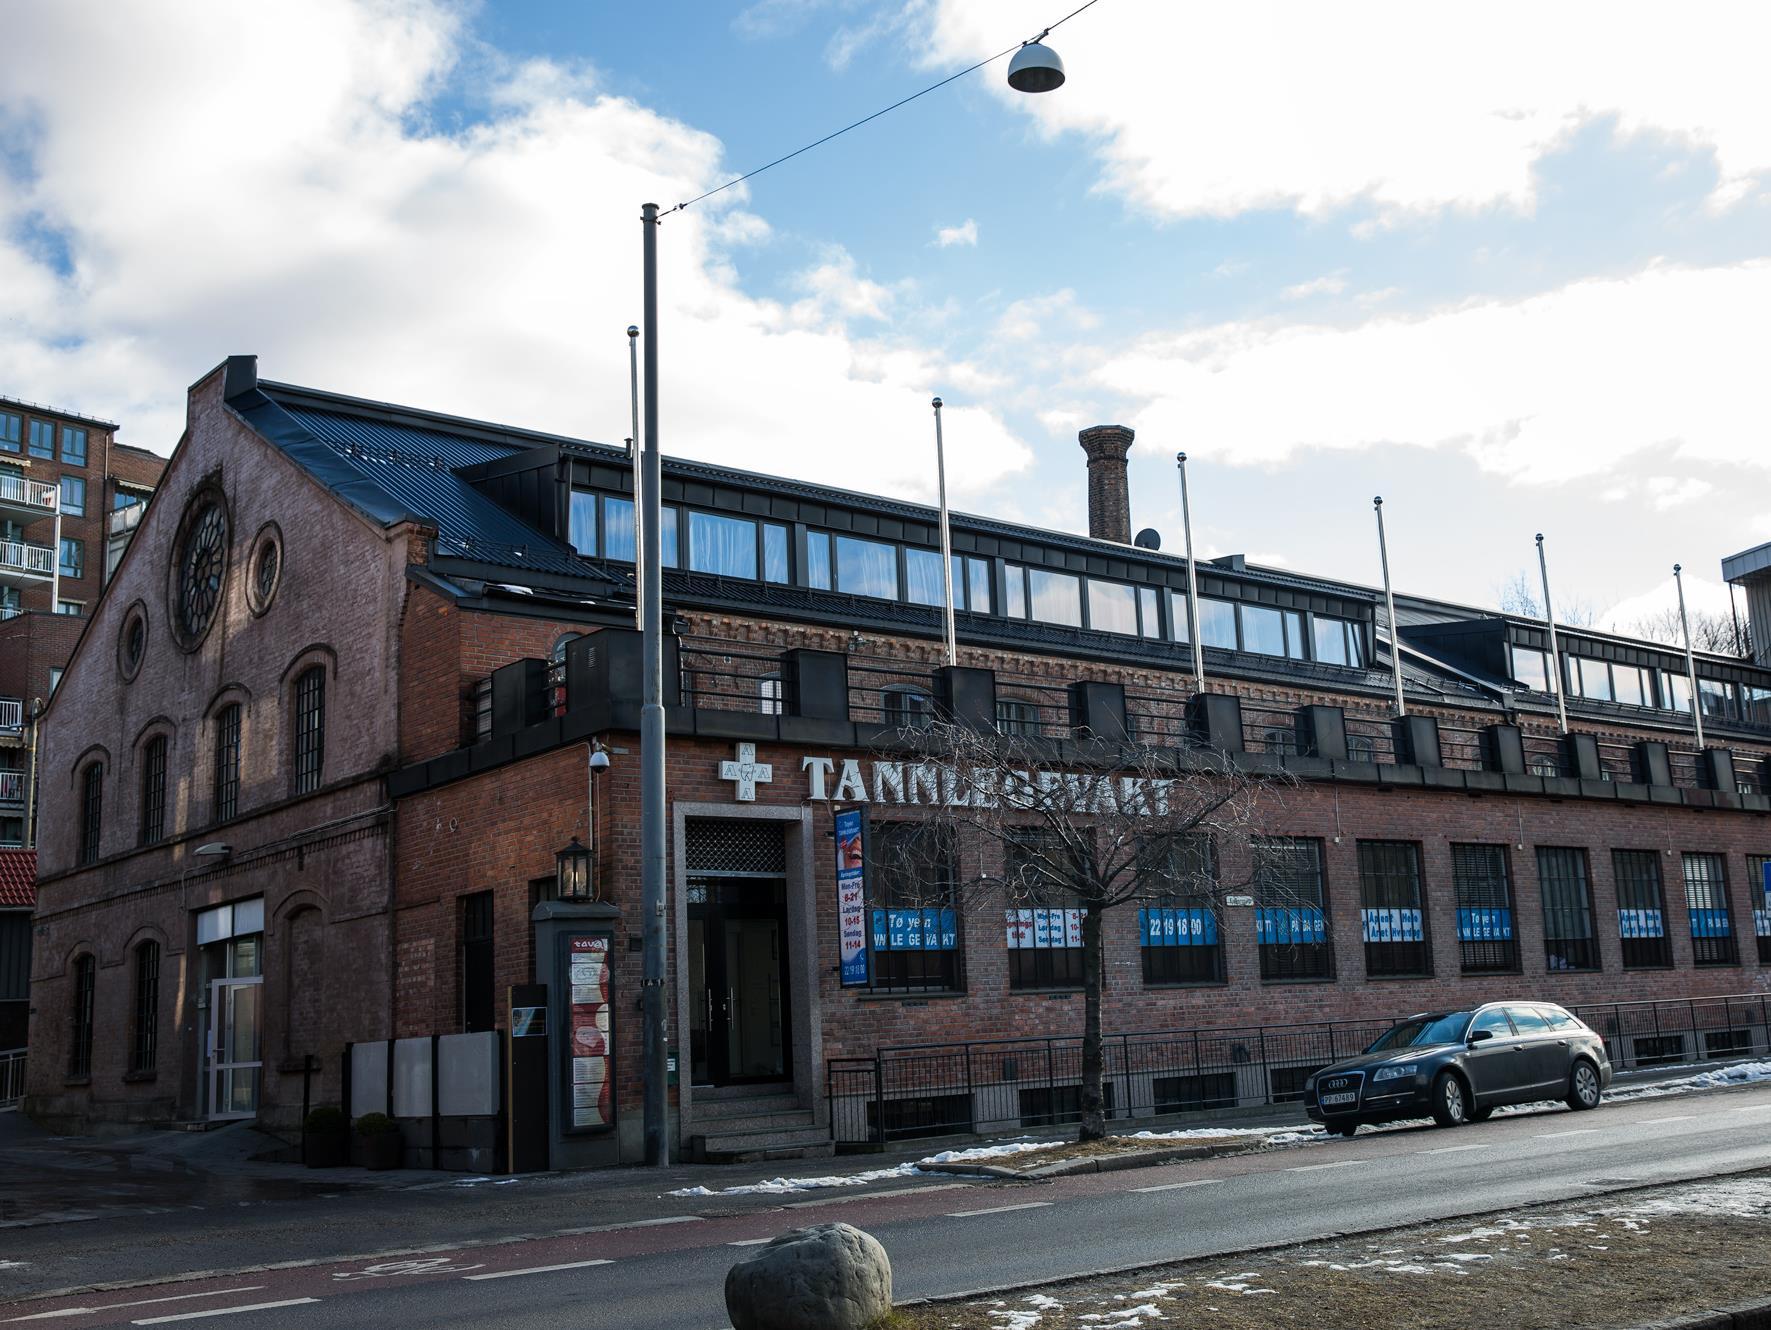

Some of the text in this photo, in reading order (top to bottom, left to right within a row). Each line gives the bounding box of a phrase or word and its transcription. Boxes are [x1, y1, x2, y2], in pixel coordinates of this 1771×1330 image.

[741, 744, 754, 756] A
[724, 764, 737, 776] A
[757, 766, 771, 779] A
[741, 787, 754, 800] A
[1150, 918, 1202, 936] 22 19 18 00
